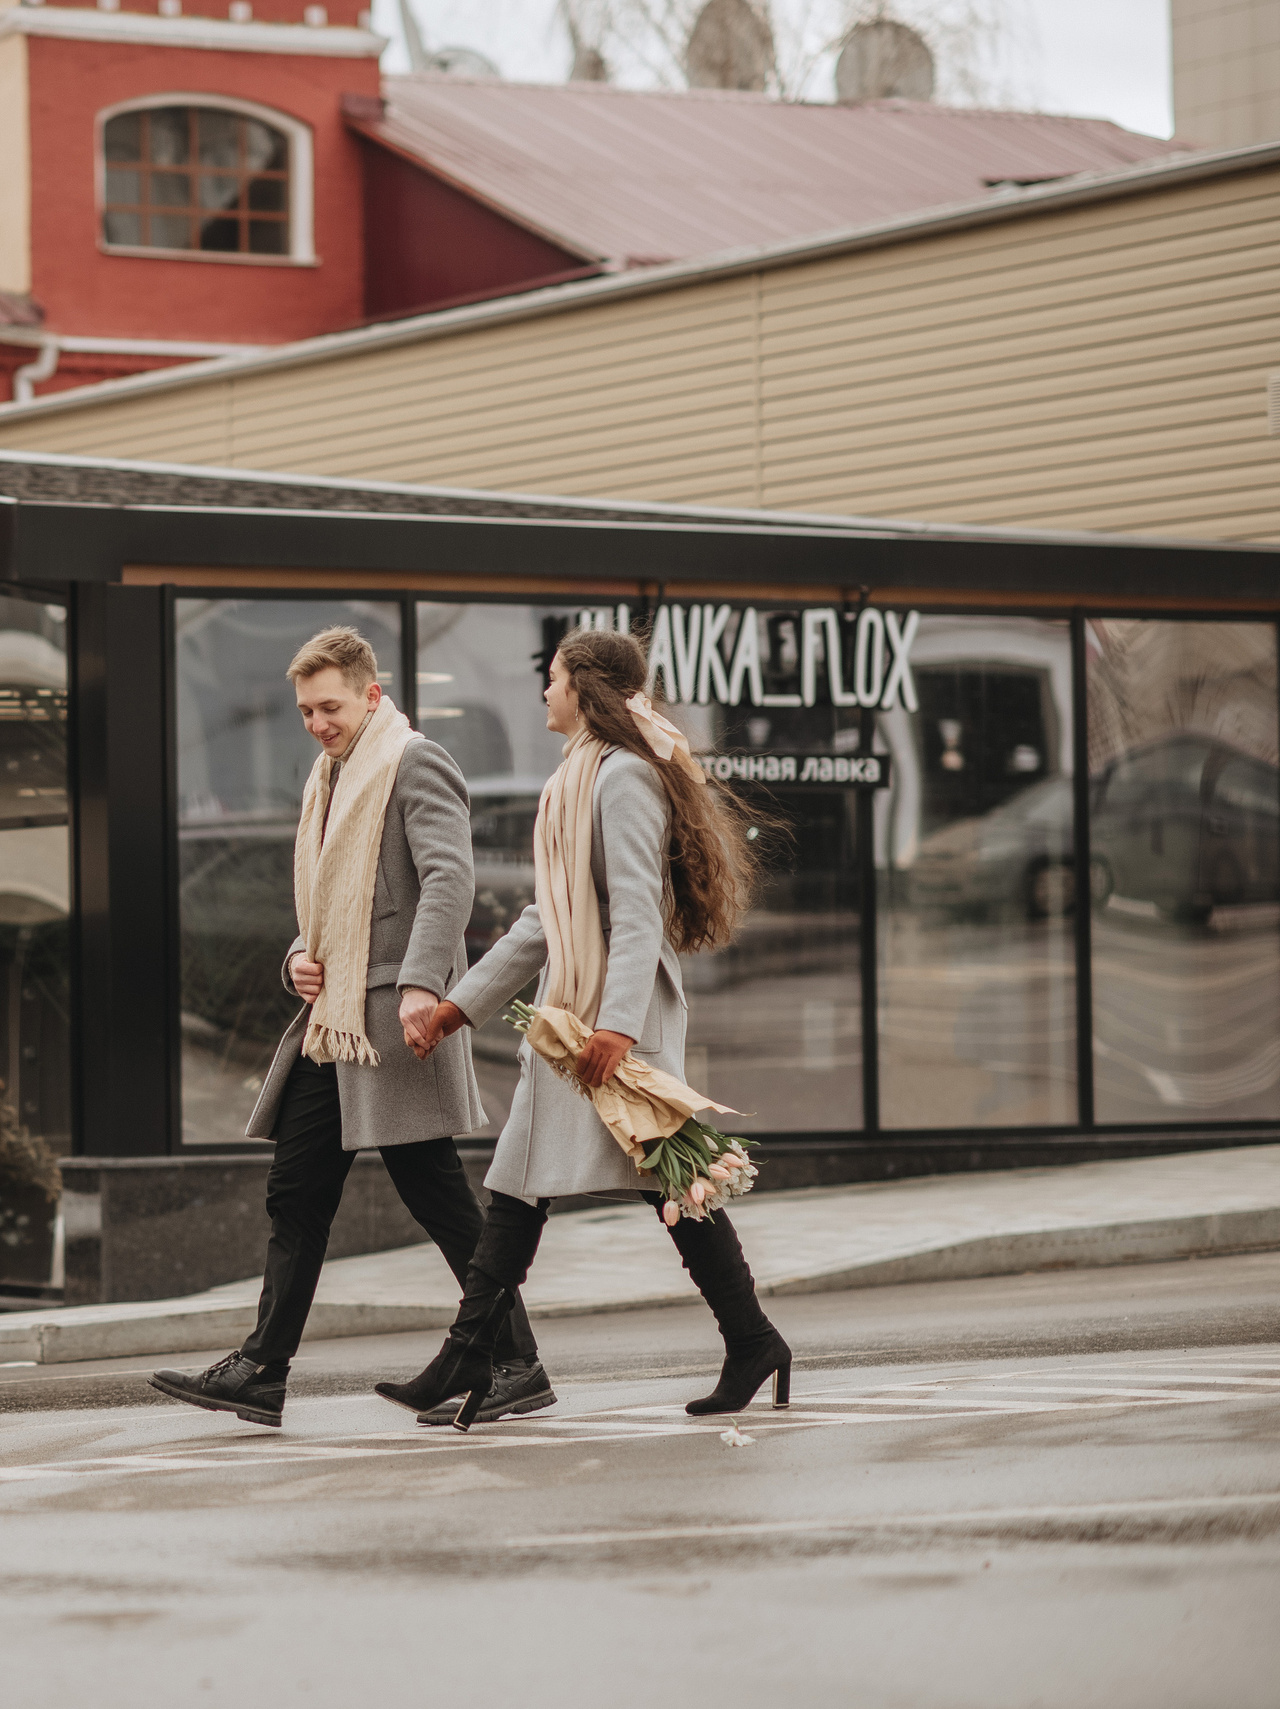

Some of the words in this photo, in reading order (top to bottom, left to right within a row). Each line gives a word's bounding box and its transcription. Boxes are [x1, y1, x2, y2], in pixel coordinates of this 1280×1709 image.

[579, 603, 920, 713] AVKA_FLOX
[695, 755, 797, 782] точная
[800, 756, 881, 783] лавка
